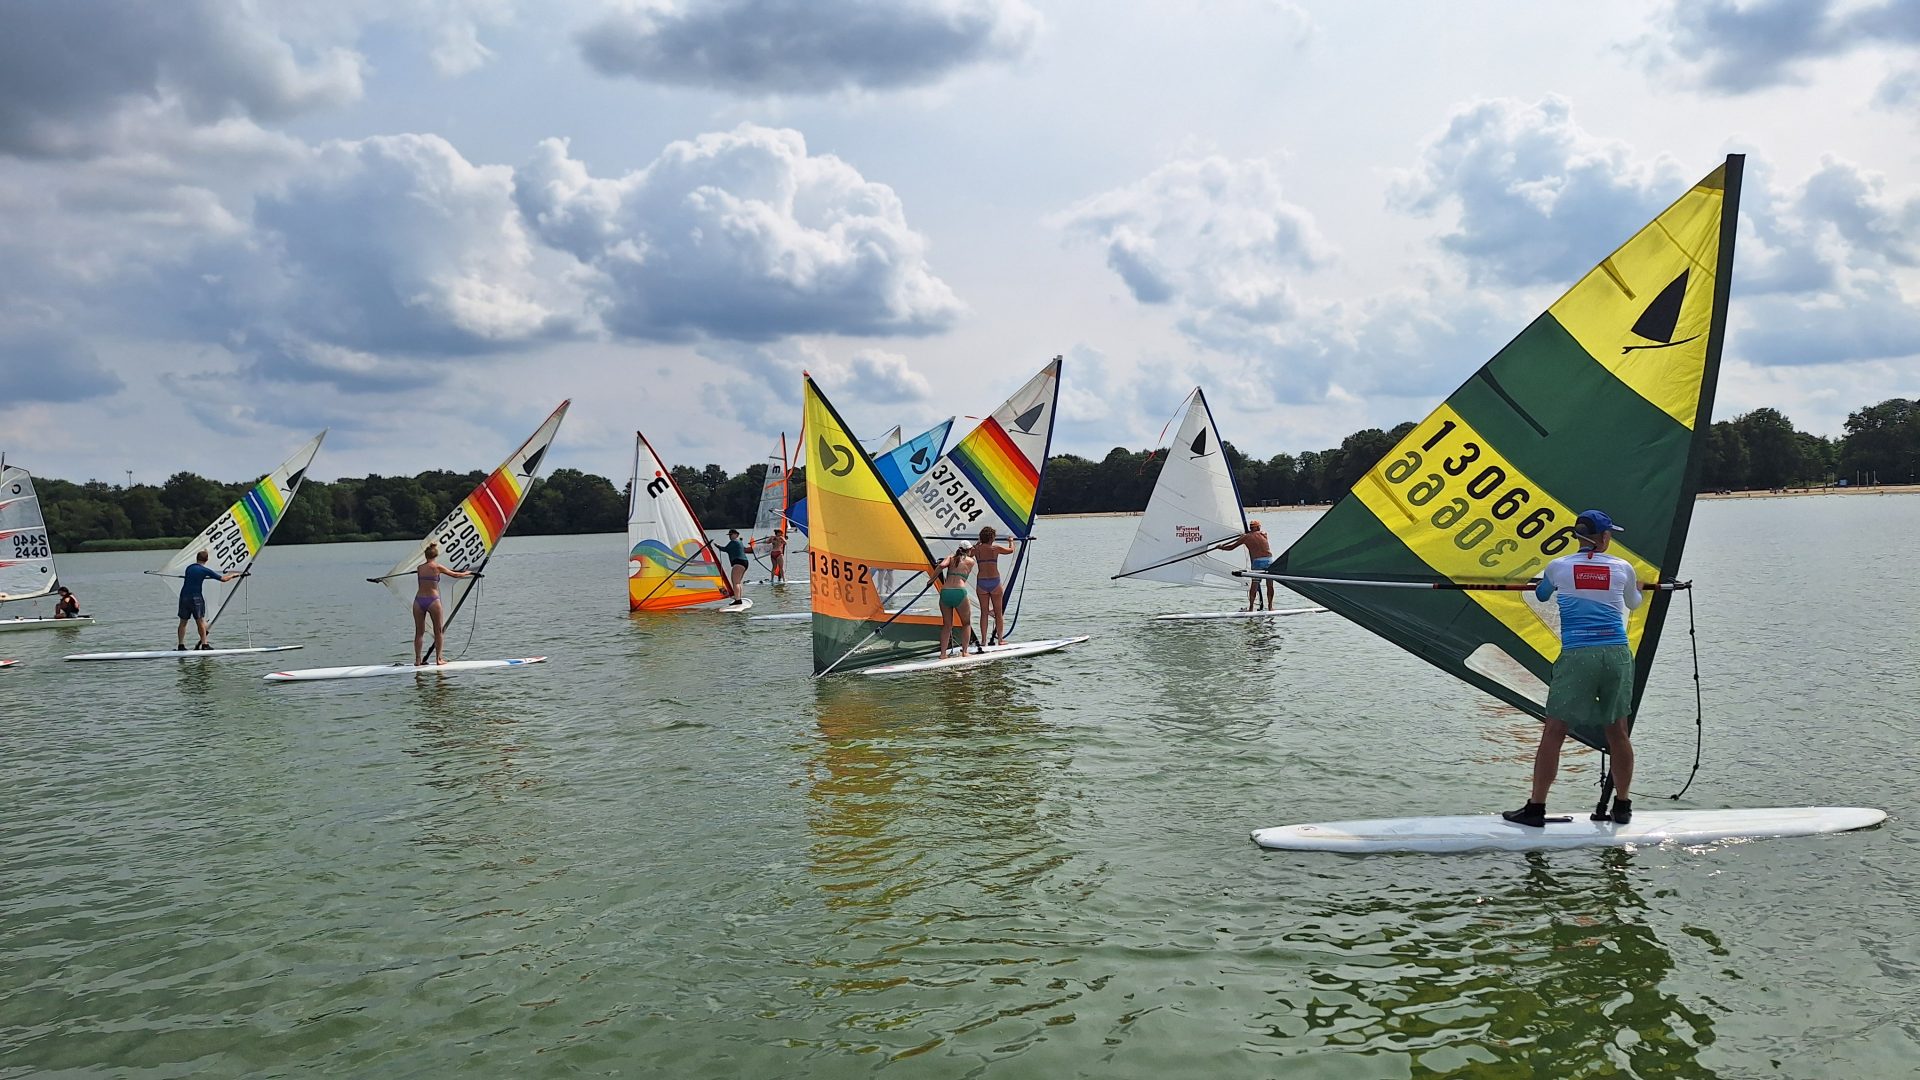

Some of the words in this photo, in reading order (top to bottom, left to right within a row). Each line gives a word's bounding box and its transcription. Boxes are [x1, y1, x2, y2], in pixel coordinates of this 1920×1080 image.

[932, 464, 983, 523] 375184
[1421, 420, 1577, 556] 130666
[15, 546, 48, 559] 2440
[218, 513, 249, 564] 370496
[448, 507, 486, 563] 370659
[810, 551, 868, 584] 13652
